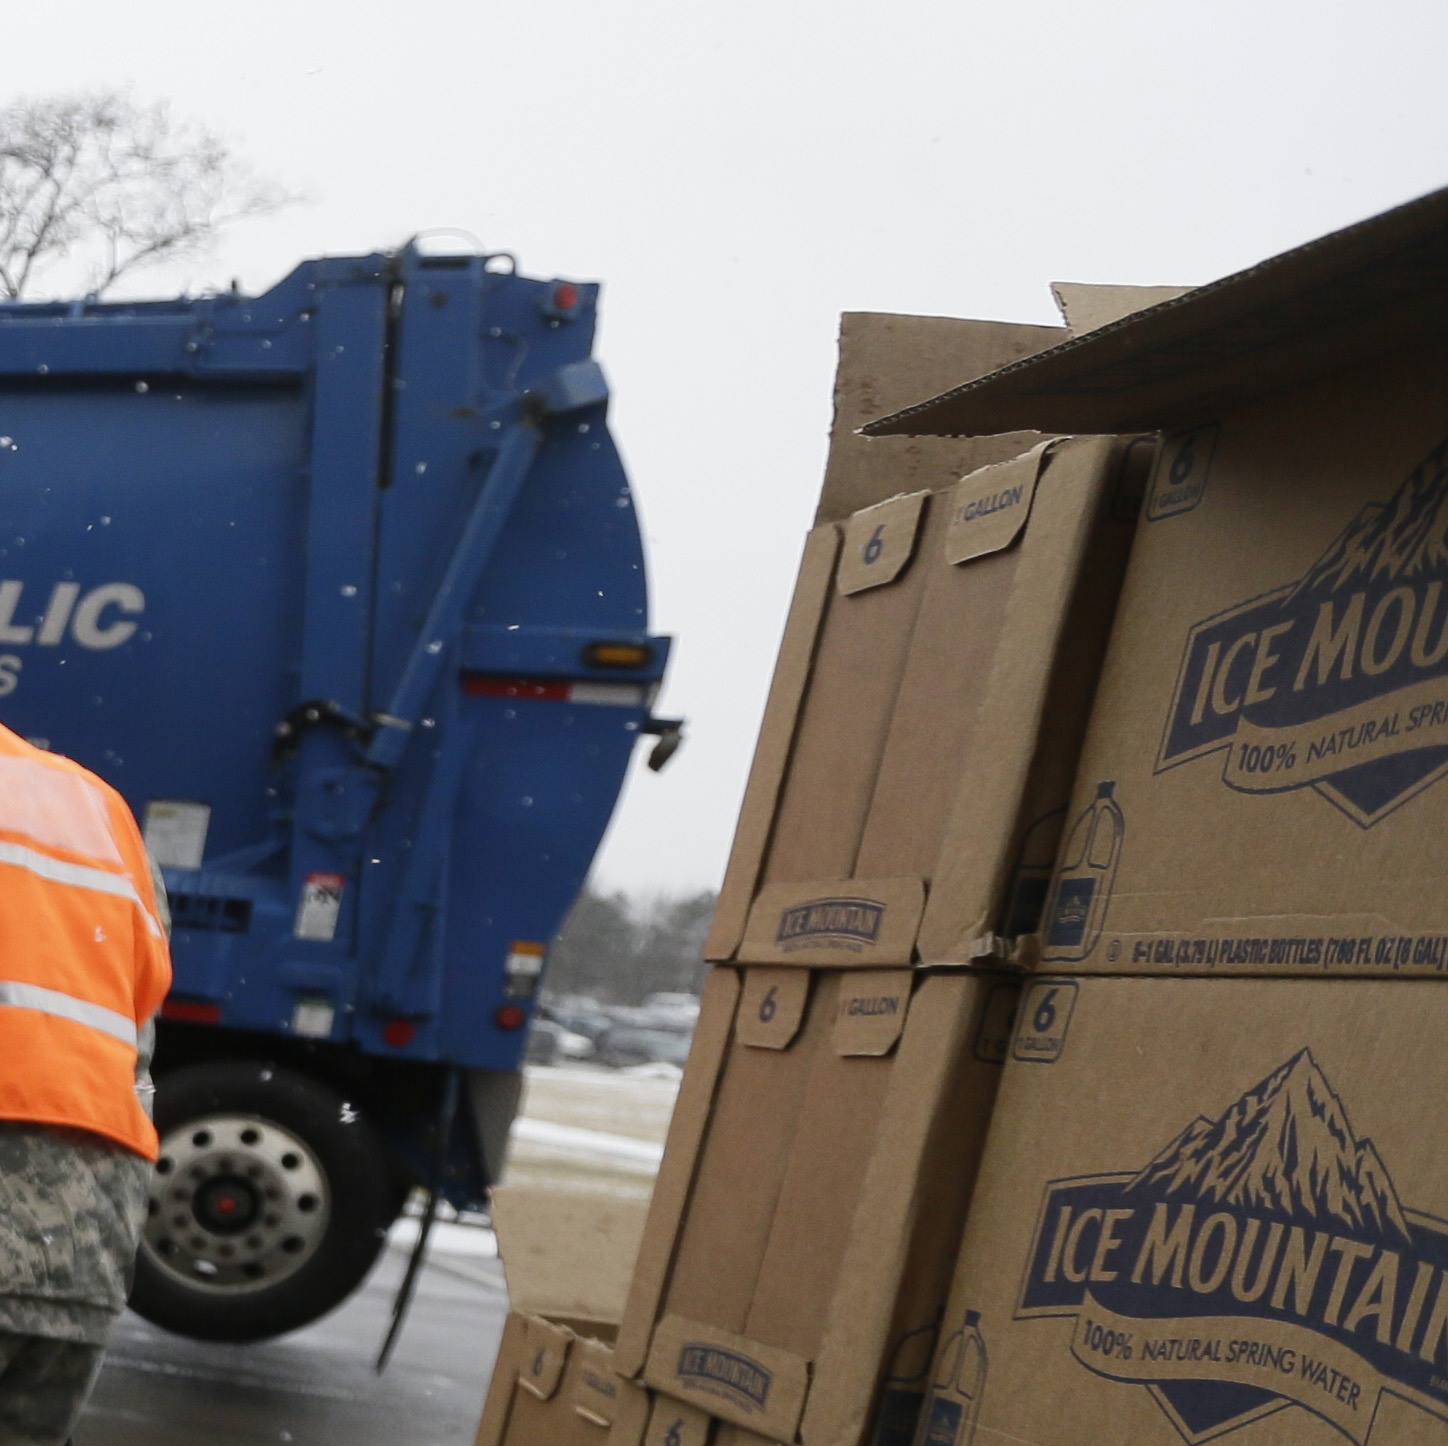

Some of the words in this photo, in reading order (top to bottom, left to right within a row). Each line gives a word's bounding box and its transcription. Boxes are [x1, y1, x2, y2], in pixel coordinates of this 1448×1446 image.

[1169, 433, 1196, 485] 6
[965, 485, 1024, 520] GALLON
[863, 525, 885, 565] 6
[1190, 619, 1296, 727] ICE
[1238, 741, 1297, 773] 100%
[1306, 713, 1400, 765] NATURAL
[1219, 939, 1269, 964] PLASTIC
[1270, 938, 1323, 964] BOTTLES
[760, 985, 779, 1023] 6
[849, 997, 900, 1017] GALLON
[1034, 988, 1059, 1033] 6
[1043, 1204, 1135, 1284] ICE
[1083, 1319, 1134, 1360] 100%
[1141, 1339, 1221, 1363] NATURAL
[1225, 1339, 1296, 1375] SPRING
[1300, 1354, 1362, 1411] WATER
